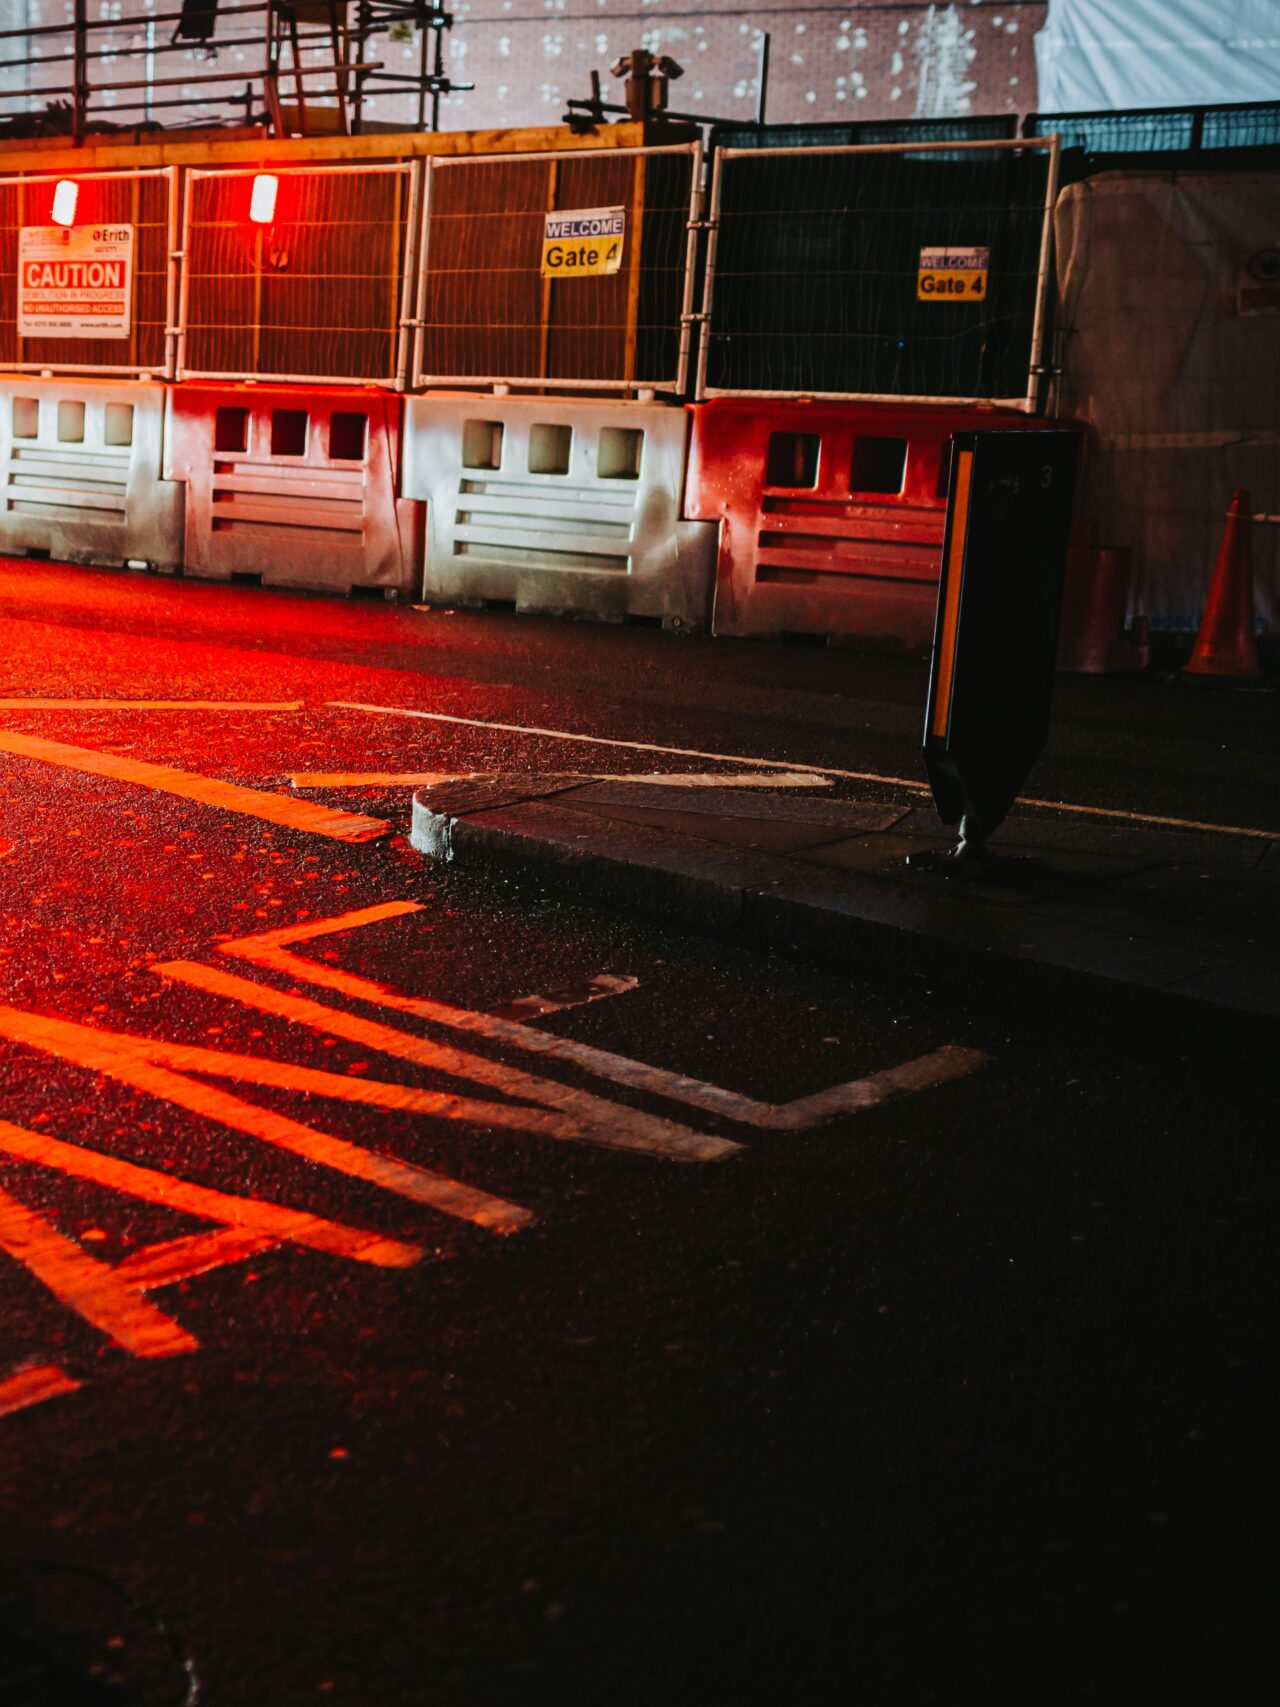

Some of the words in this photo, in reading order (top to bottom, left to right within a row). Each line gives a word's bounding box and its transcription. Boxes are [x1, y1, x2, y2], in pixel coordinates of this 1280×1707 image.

[102, 229, 130, 242] Erith
[547, 218, 621, 237] WELCOME
[546, 246, 599, 268] Gate
[605, 243, 618, 261] 4
[920, 256, 986, 268] WELCOME
[26, 263, 121, 287] CAUTION
[921, 275, 966, 293] Gate
[970, 276, 983, 293] 4
[80, 290, 126, 299] PROGRESS
[92, 304, 124, 313] ACCESS
[1040, 465, 1053, 488] 3
